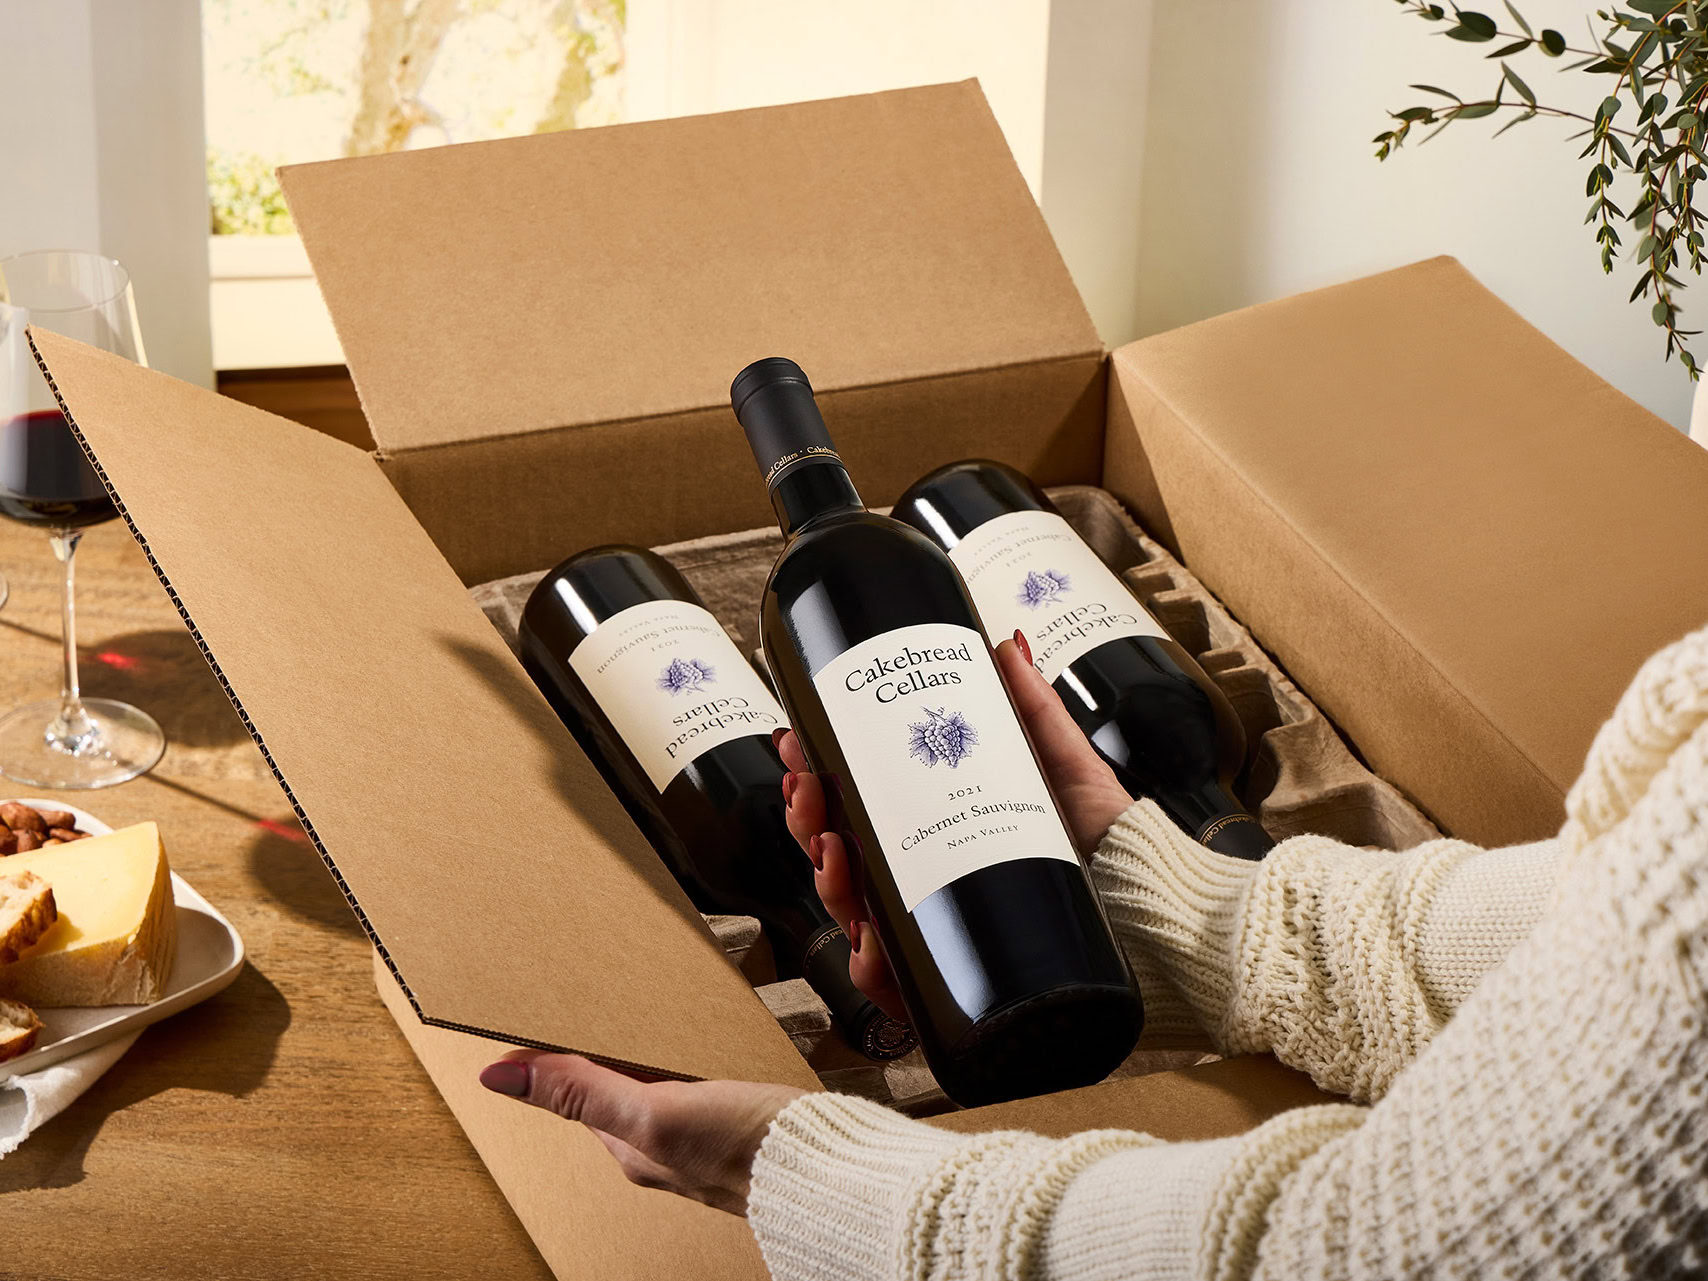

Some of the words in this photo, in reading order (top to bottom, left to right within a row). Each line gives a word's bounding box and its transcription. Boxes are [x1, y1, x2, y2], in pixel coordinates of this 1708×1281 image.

[1015, 534, 1072, 547] Cabernet
[966, 546, 1013, 584] Sauvign
[1006, 552, 1032, 568] 2021
[664, 625, 721, 638] Cabernet
[1036, 603, 1107, 641] Cellars
[597, 631, 659, 674] Sauvignon
[650, 639, 680, 652] 2021
[1034, 613, 1137, 673] Cakebread
[845, 643, 973, 692] Cakebread
[875, 669, 962, 704] Cellars
[672, 696, 749, 727] Cellars
[664, 711, 778, 759] Cakebread
[948, 785, 982, 801] 2021
[901, 811, 967, 851] Cabernet
[971, 800, 1046, 818] Sauvignon
[947, 833, 977, 850] NAPA
[980, 825, 1019, 837] VALLEY
